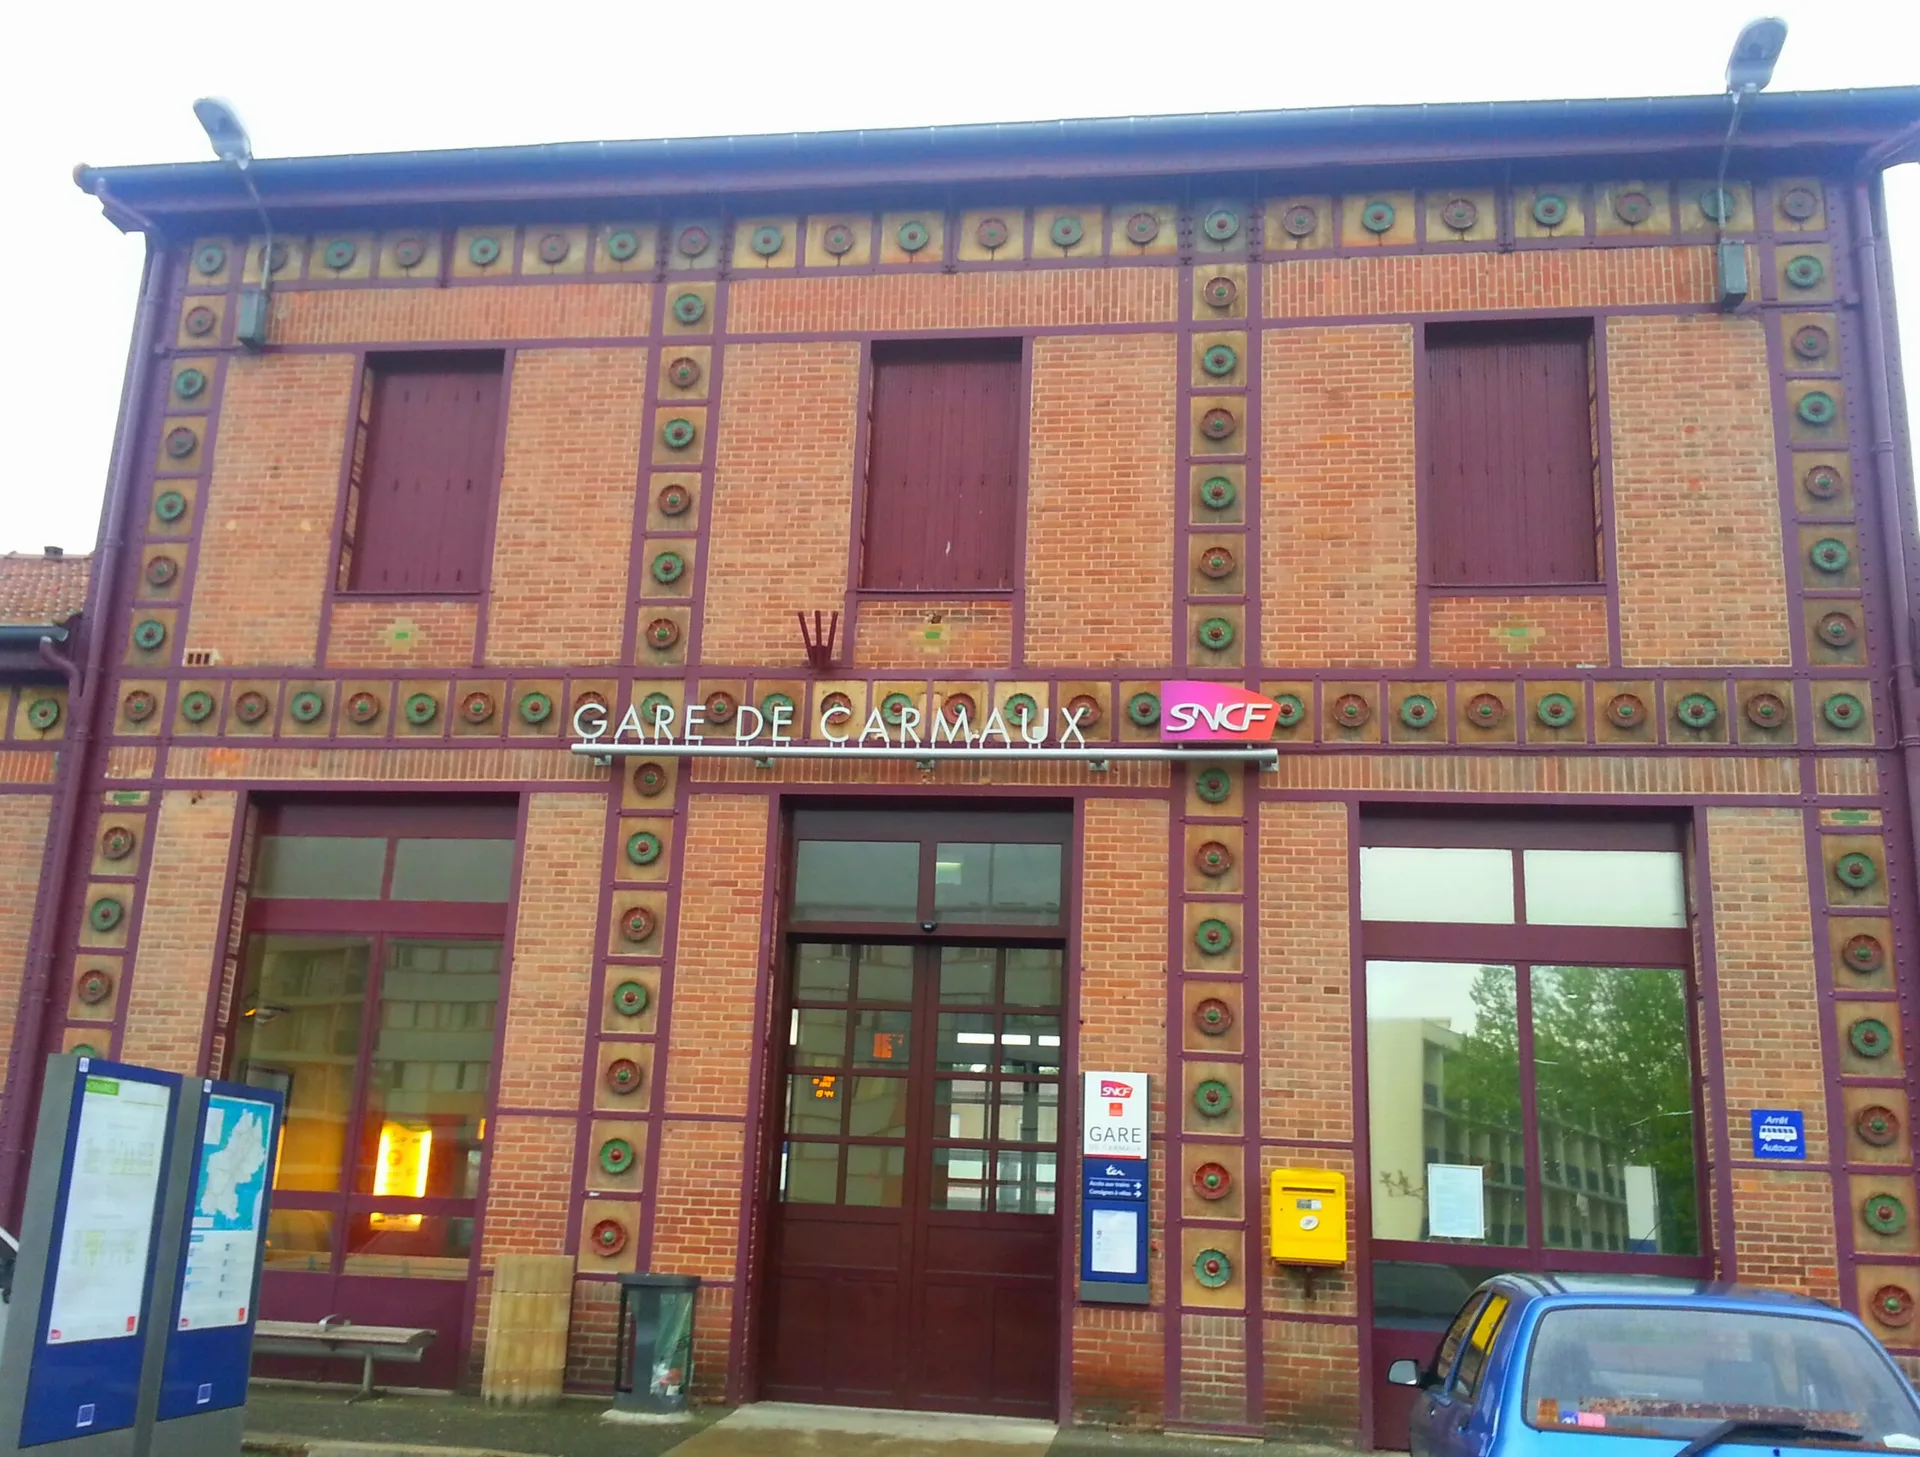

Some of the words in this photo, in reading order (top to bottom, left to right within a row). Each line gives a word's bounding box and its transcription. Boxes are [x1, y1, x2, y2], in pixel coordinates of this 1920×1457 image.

[573, 703, 707, 740] GARE
[736, 705, 794, 742] DE
[820, 706, 1086, 744] CARMAUX
[1166, 703, 1273, 732] SNCF
[1101, 1086, 1132, 1096] SNCF
[1765, 1115, 1789, 1125] Arrêt
[1089, 1126, 1142, 1143] GARE
[1761, 1143, 1798, 1152] Autocar
[1105, 1164, 1126, 1176] ter
